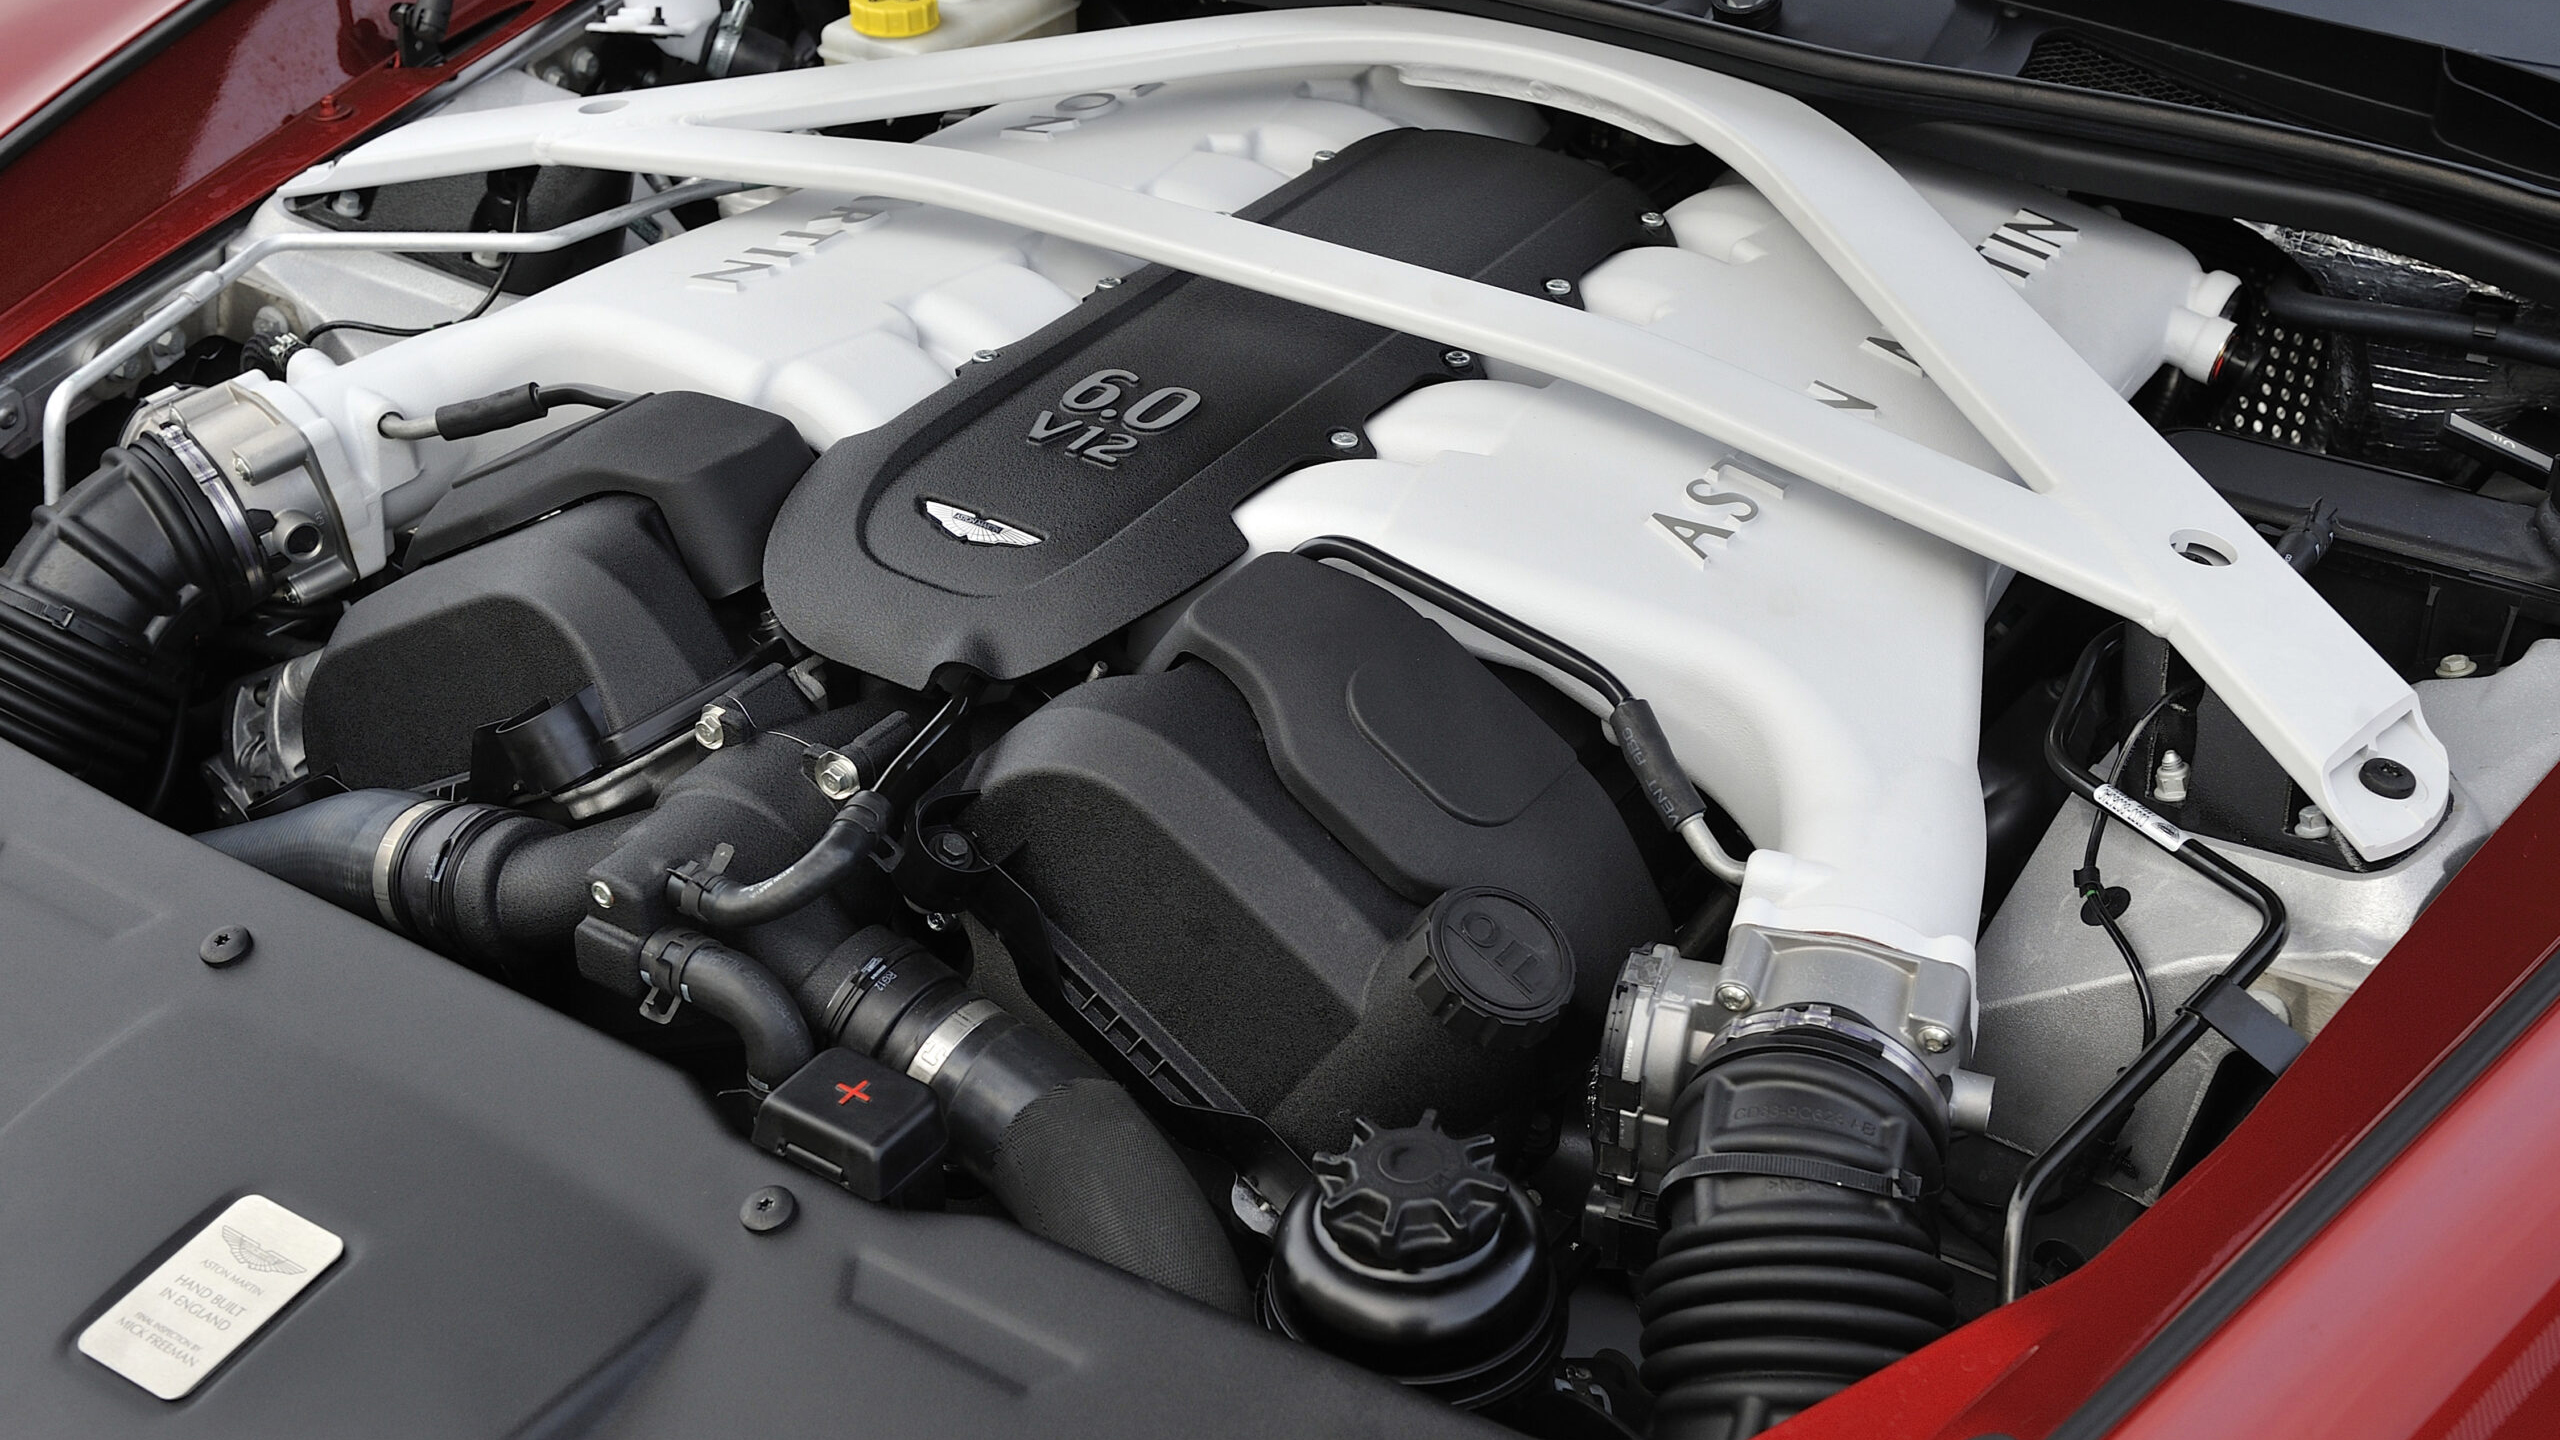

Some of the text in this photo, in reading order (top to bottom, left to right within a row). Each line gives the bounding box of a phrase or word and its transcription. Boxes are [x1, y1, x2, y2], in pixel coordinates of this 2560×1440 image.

[1060, 369, 1201, 434] 6.0
[1026, 410, 1138, 469] V12
[1646, 779, 1680, 826] VENT
[1461, 911, 1546, 996] OIL
[175, 1274, 248, 1318] HAND BUILT
[200, 1258, 265, 1298] ASTON MARTIN
[159, 1286, 232, 1332] IN ENGLAND
[116, 1316, 201, 1369] MICK FREEMAN
[150, 1322, 193, 1348] INSPECTION
